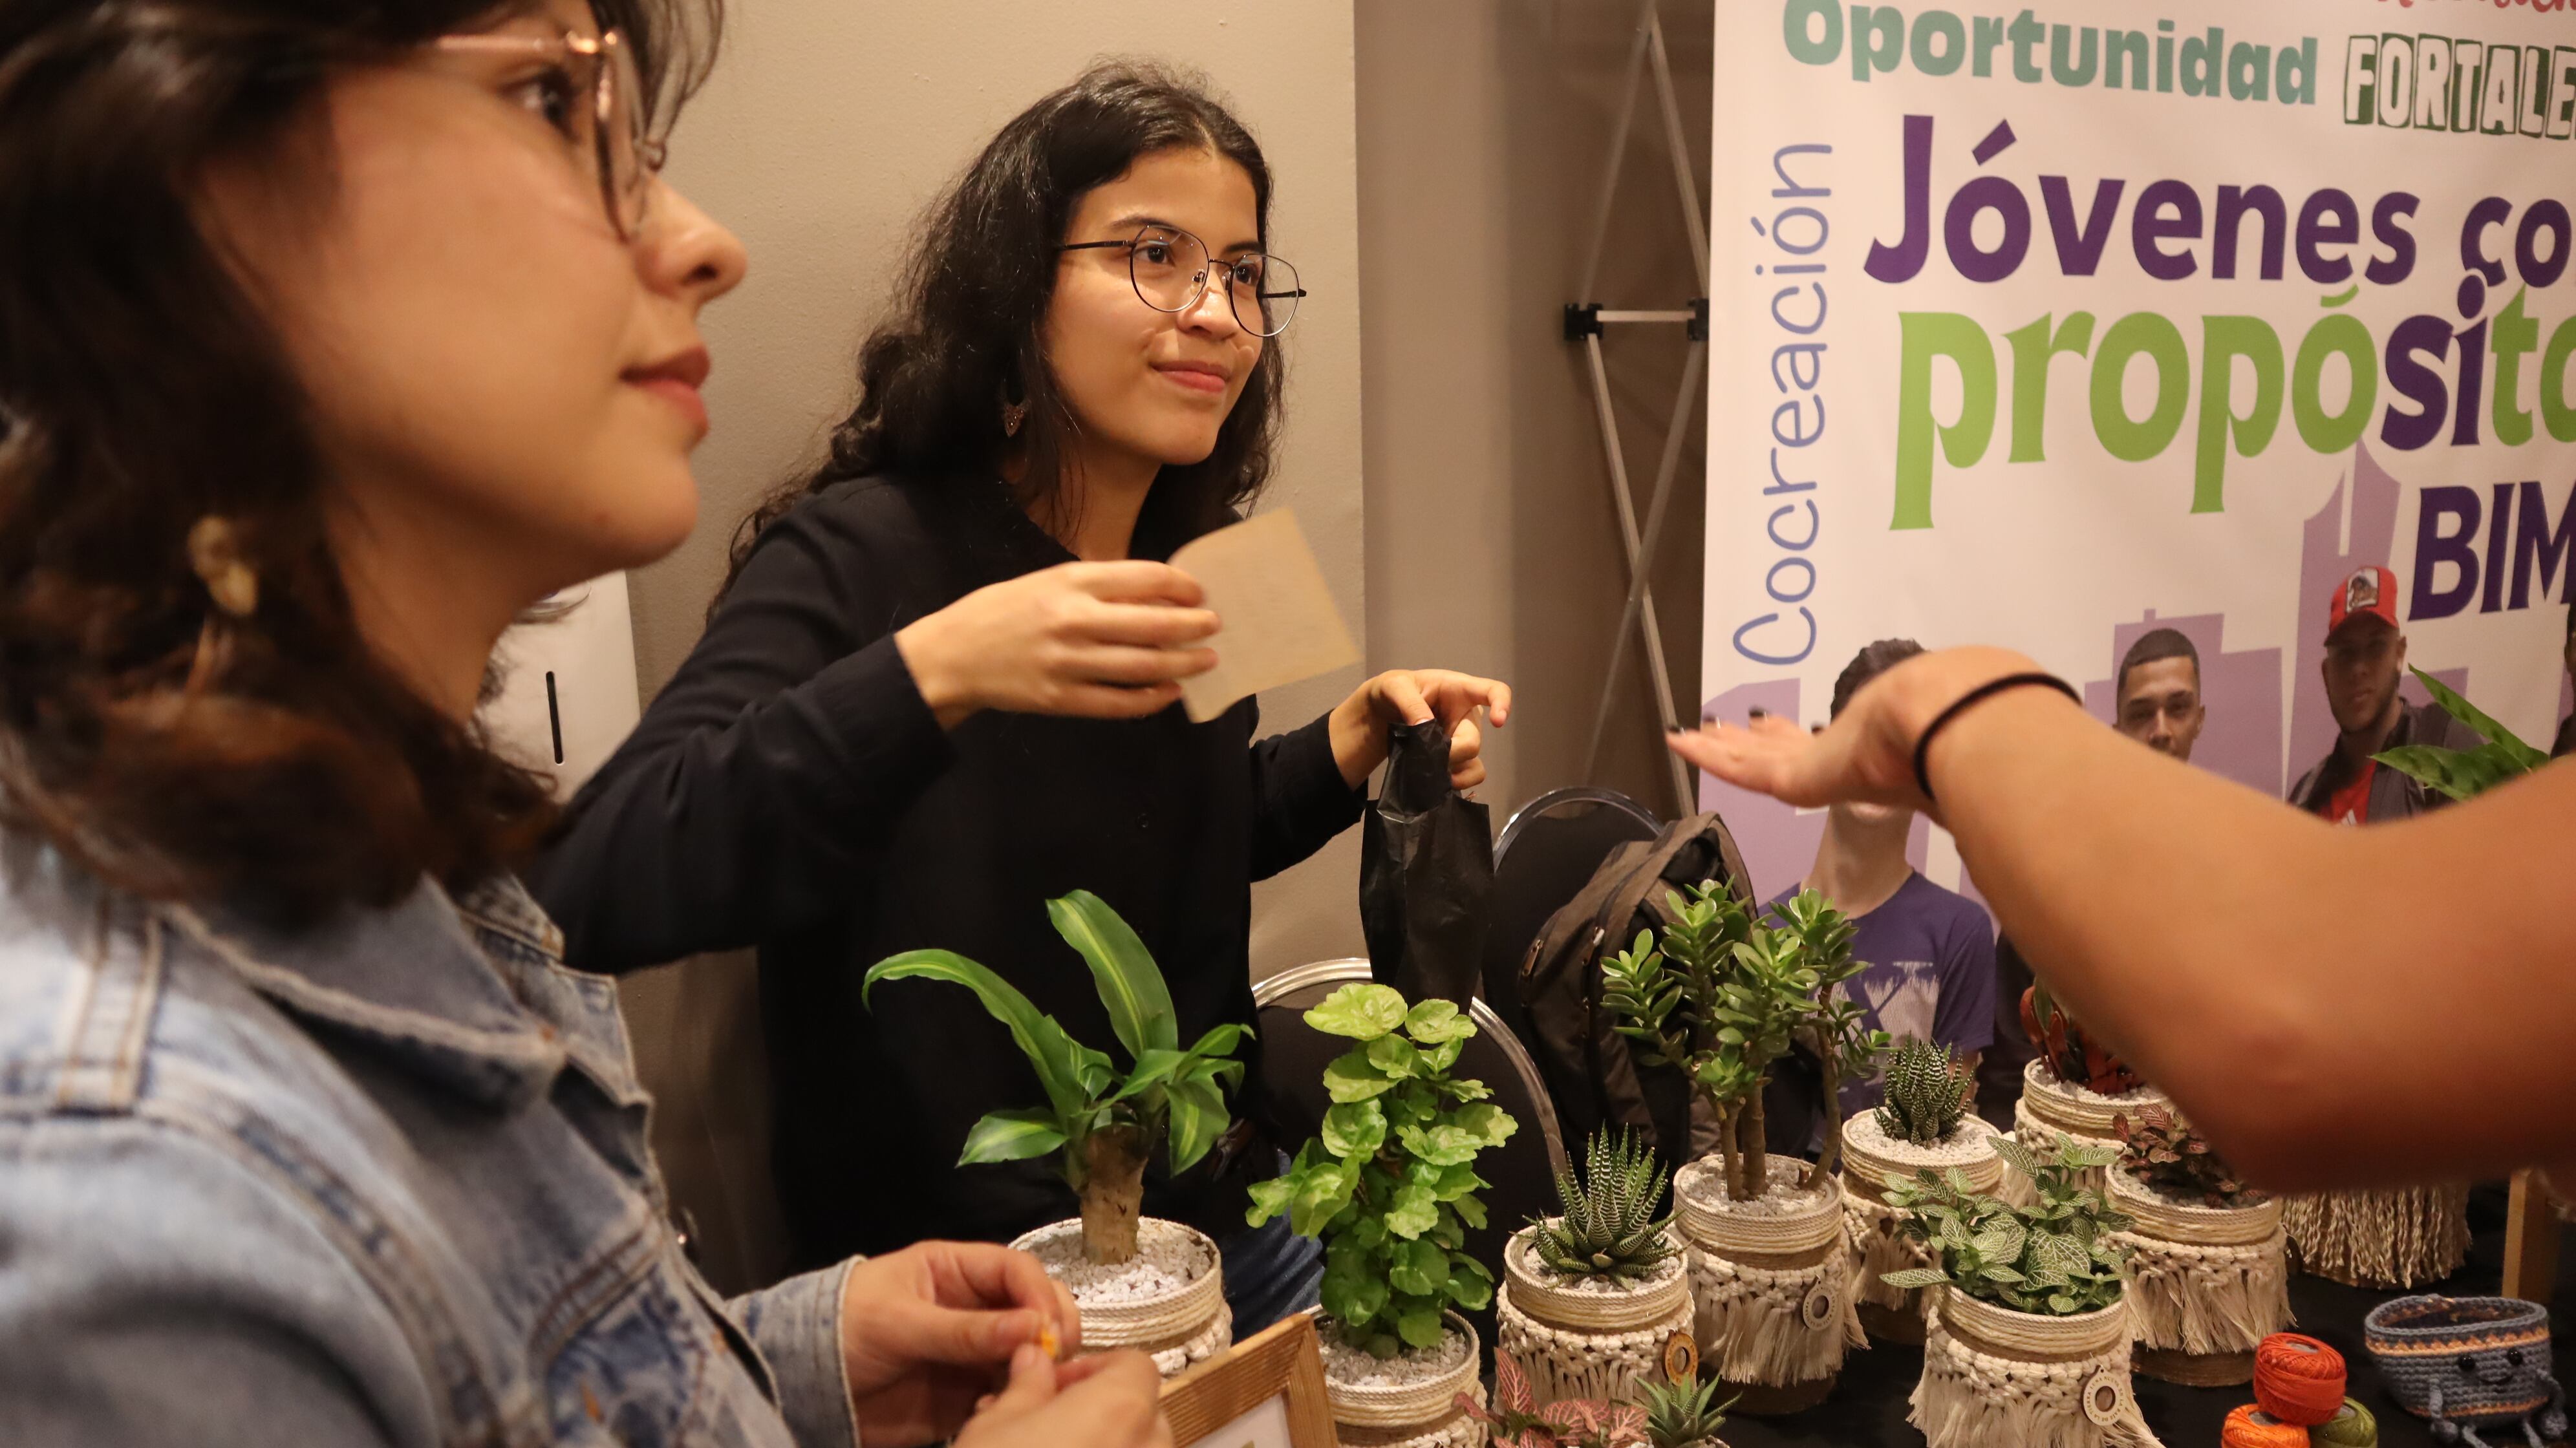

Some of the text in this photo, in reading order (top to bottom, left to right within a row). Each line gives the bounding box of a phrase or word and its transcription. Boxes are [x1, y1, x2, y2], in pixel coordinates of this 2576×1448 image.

[1783, 0, 2318, 105] Oportunidad
[1863, 114, 2421, 285] Jóvenes
[1733, 144, 1833, 666] Cocreación
